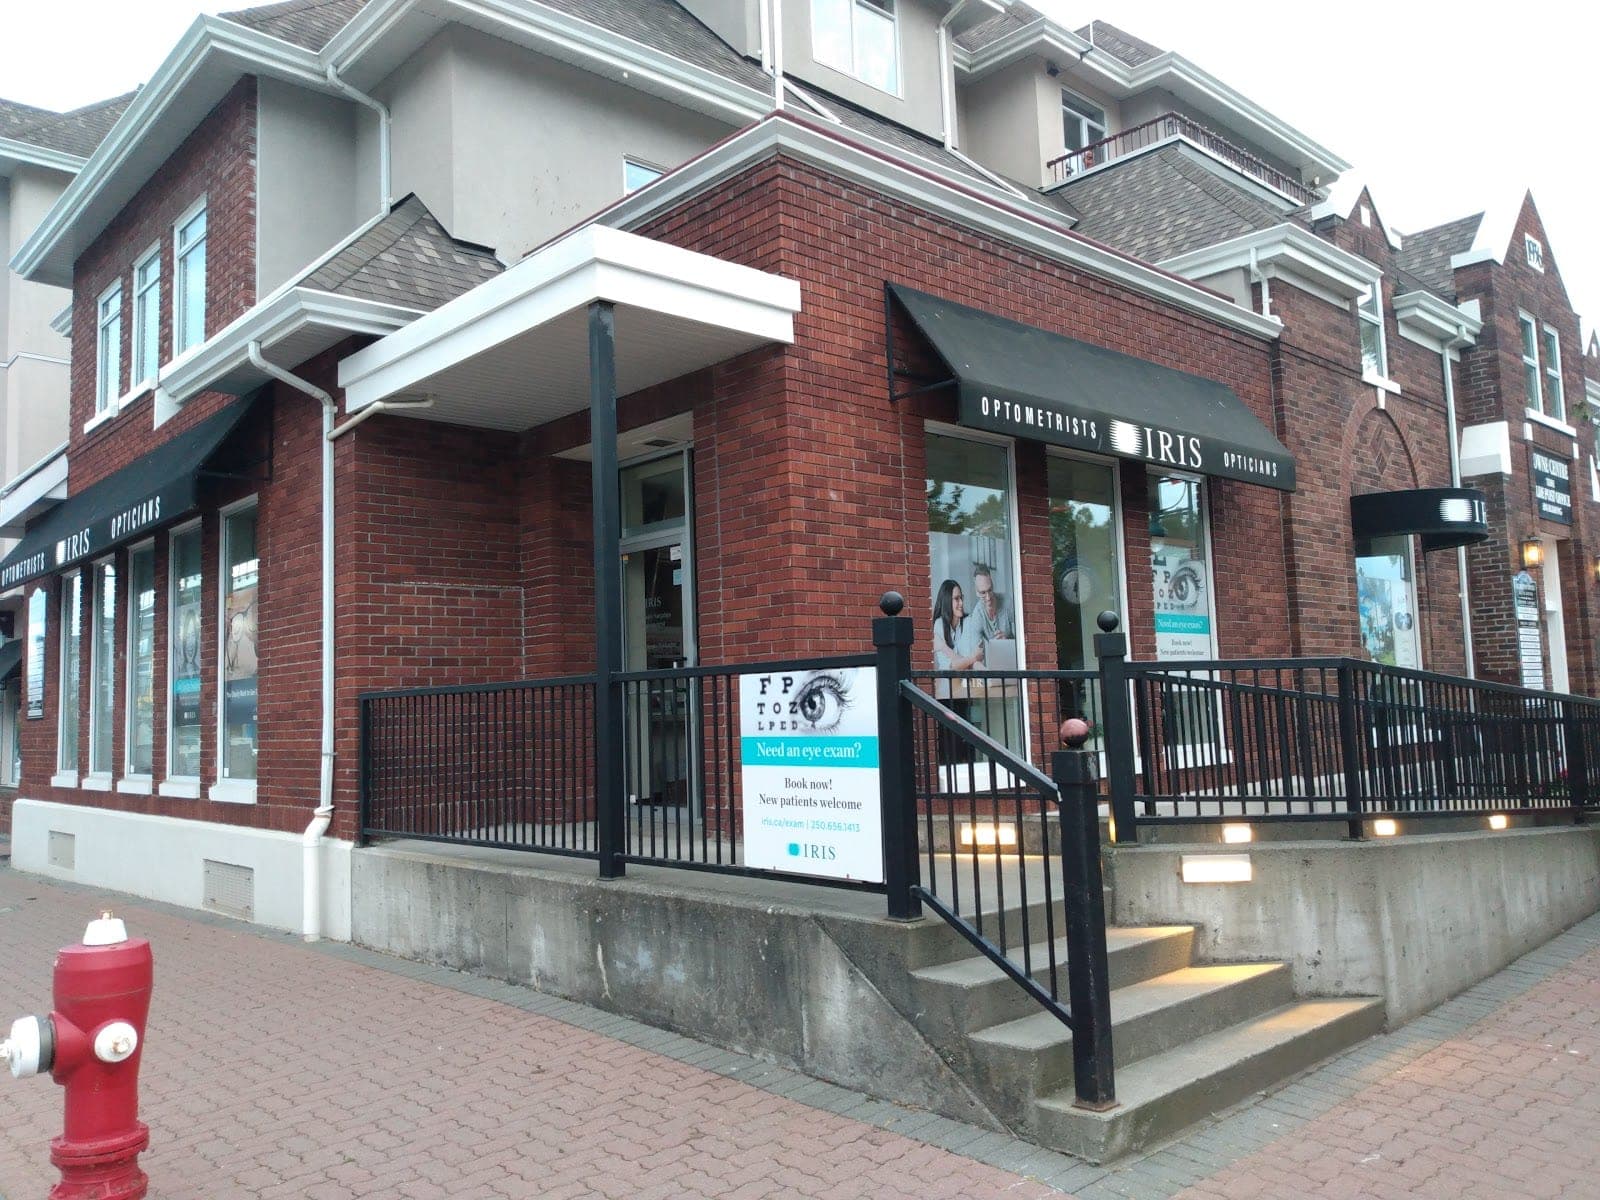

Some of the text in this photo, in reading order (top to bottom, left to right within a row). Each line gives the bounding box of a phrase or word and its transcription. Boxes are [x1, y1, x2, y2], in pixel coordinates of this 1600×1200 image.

[981, 396, 1278, 478] OPTOMETRISTS IRIS OPTICIANS
[1, 495, 161, 587] OPTOMETRISTS IRIS OPTICIANS
[756, 742, 862, 761] Need an eye exam?
[784, 777, 832, 790] Book now!
[759, 793, 863, 809] New patients welcome
[762, 816, 804, 828] iris.ca/exam
[804, 843, 836, 860] IRIS
